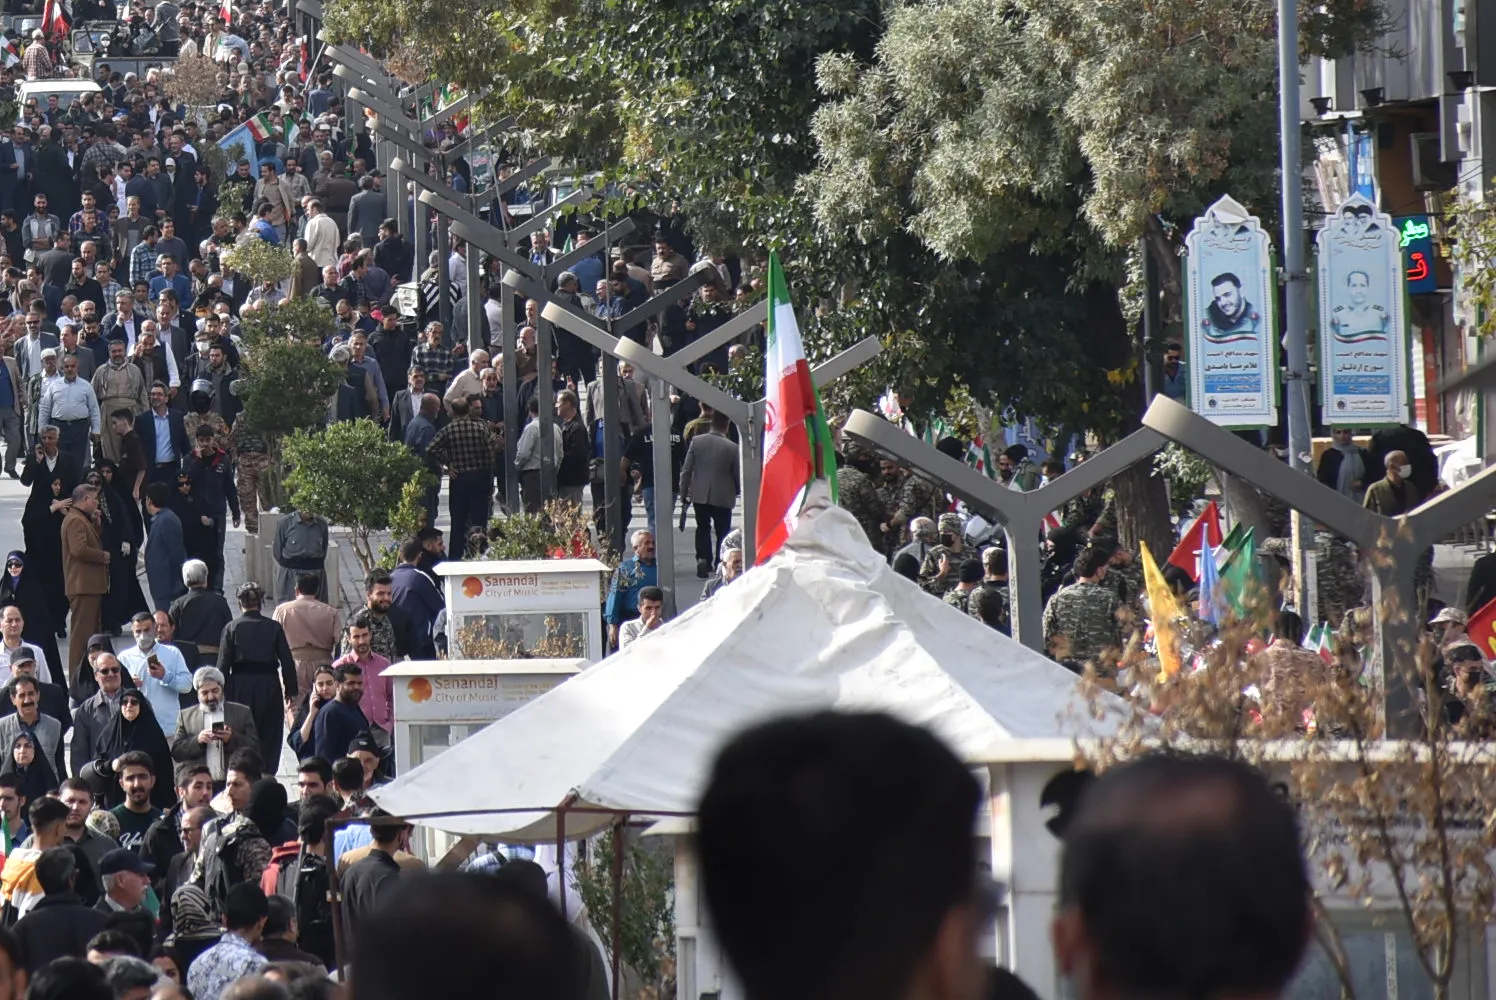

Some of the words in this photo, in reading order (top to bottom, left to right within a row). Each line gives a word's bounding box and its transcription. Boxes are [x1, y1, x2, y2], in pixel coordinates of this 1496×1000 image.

[484, 574, 538, 588] Sanandaj
[485, 589, 502, 599] City
[503, 589, 512, 598] of
[514, 588, 539, 597] Music
[434, 675, 498, 690] Sanandaj
[435, 693, 455, 704] City
[456, 693, 466, 702] of
[469, 692, 498, 702] Music
